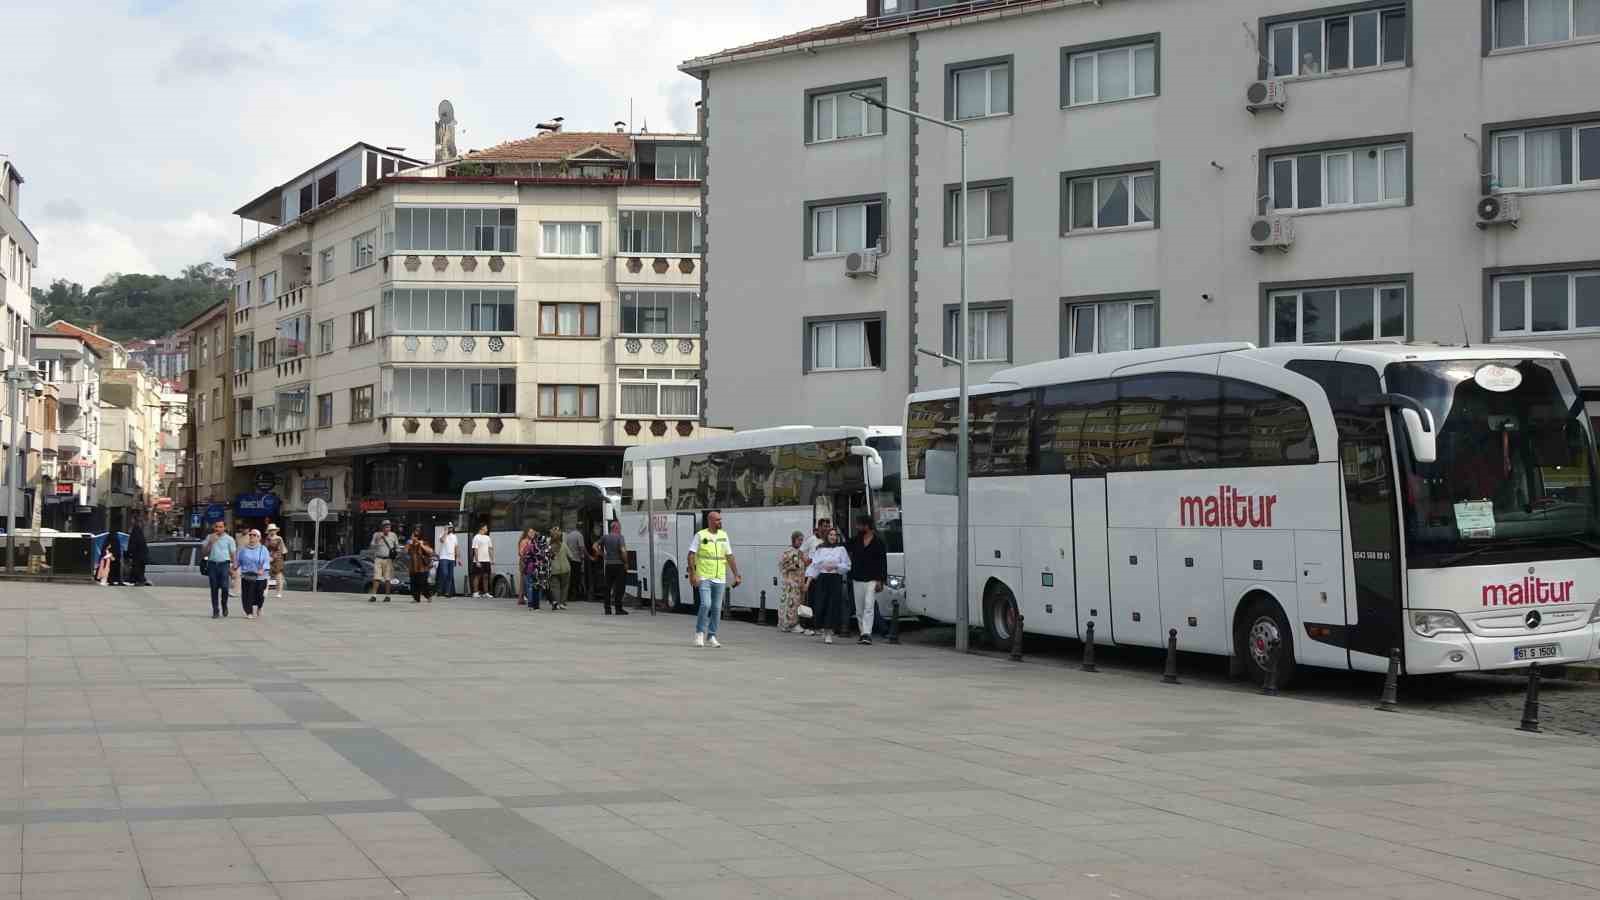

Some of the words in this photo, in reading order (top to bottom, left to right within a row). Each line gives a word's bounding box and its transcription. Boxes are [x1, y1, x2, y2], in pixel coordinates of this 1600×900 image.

[1180, 484, 1277, 527] malitur
[1482, 576, 1574, 606] malitur
[1530, 648, 1536, 657] S
